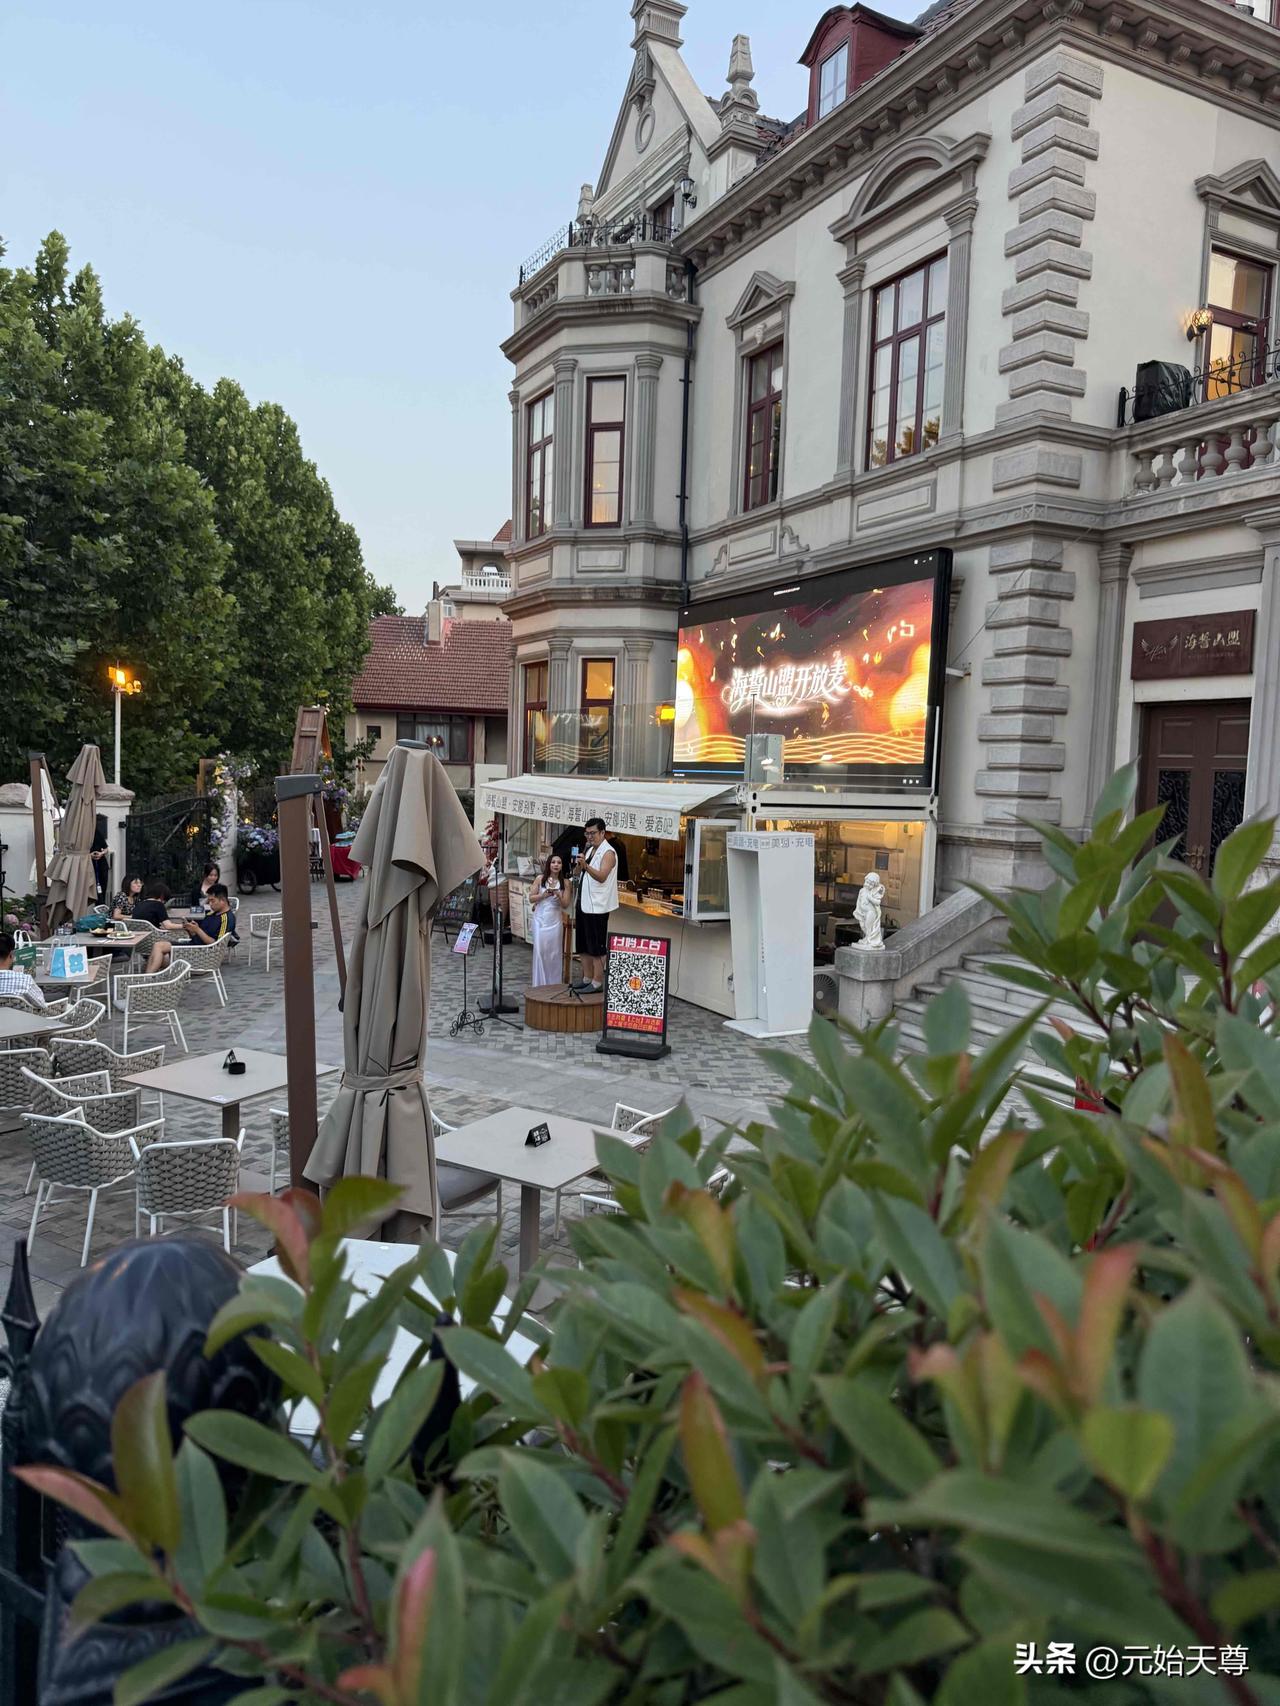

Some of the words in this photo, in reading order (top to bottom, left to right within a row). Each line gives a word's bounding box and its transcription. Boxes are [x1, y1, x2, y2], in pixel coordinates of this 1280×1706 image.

[727, 657, 850, 705] 海誓山盟开放麦
